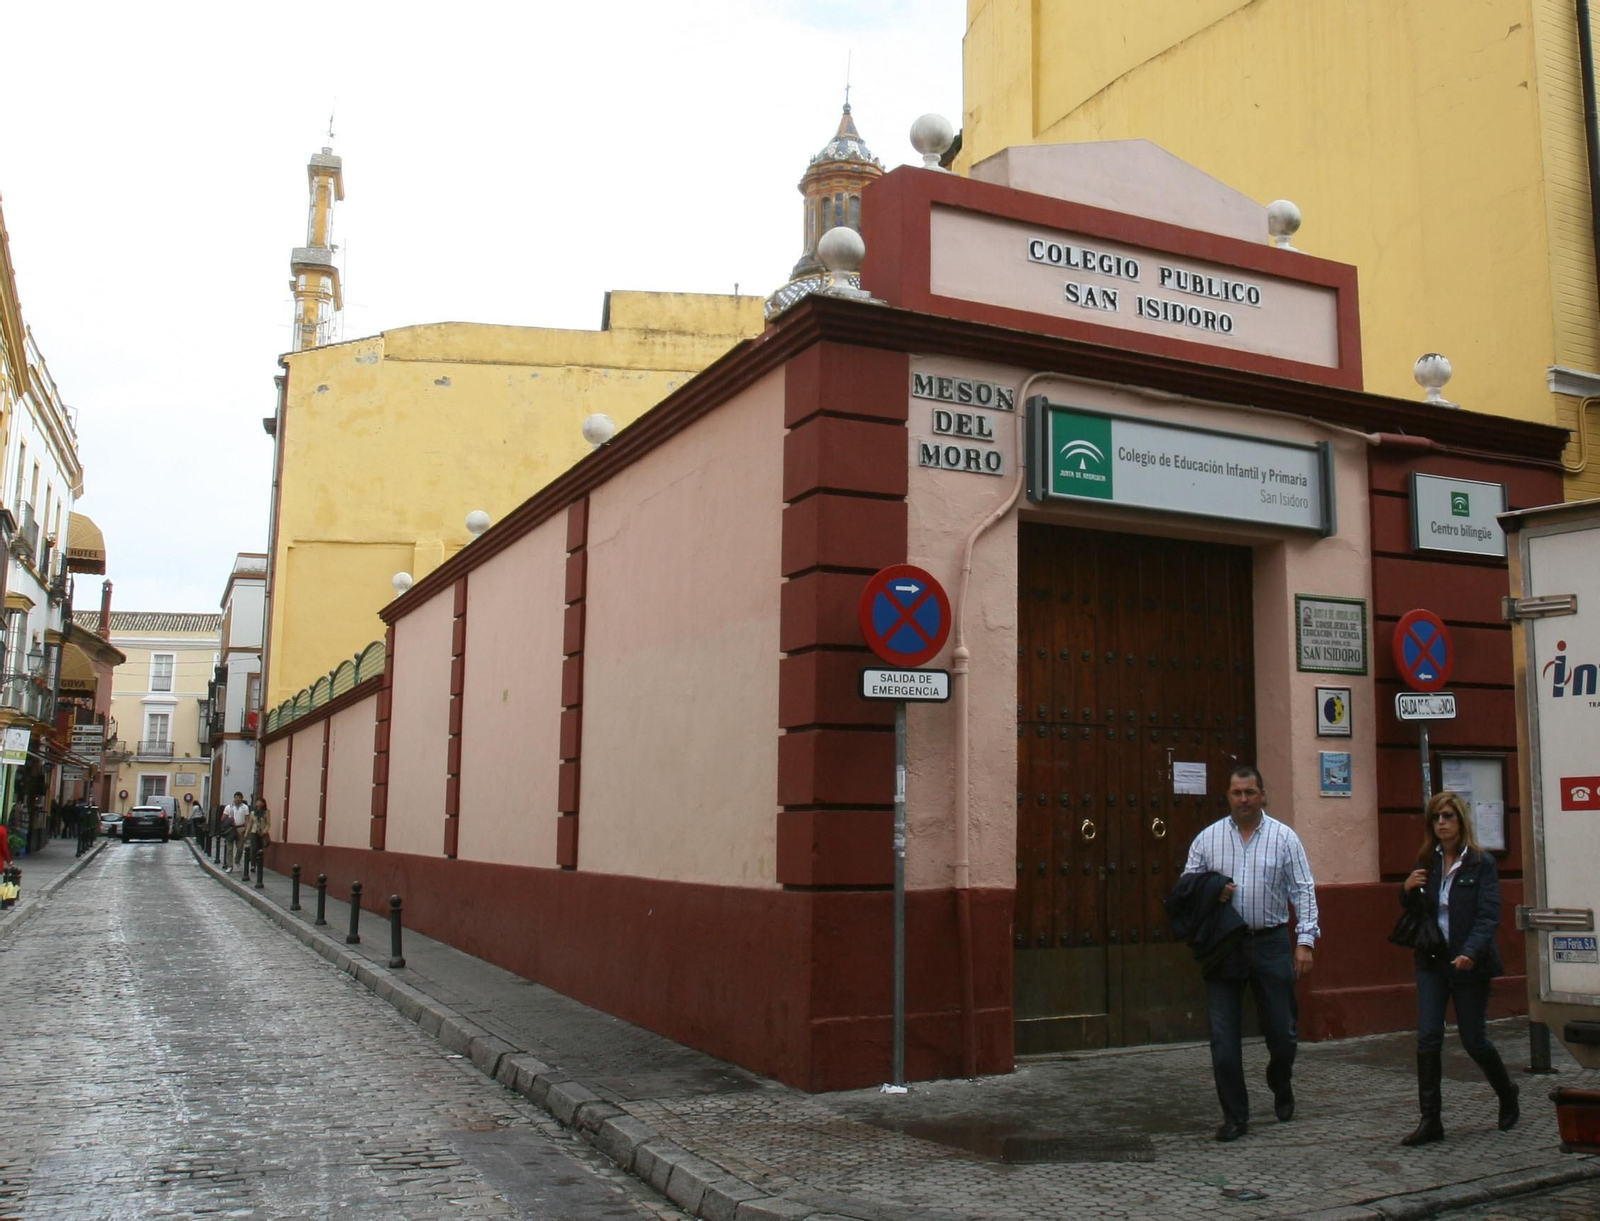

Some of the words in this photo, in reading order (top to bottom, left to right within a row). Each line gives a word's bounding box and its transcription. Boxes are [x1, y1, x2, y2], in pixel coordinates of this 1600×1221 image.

[1029, 239, 1139, 279] COLEGIO
[1159, 266, 1261, 305] PUBLICO
[1065, 282, 1118, 311] SAN
[1136, 294, 1233, 333] ISIDORO
[913, 373, 1014, 410] MESON
[934, 410, 993, 438] DEL
[920, 443, 1002, 472] MORO
[1118, 446, 1157, 467] Colegio
[1159, 455, 1171, 468] de
[1174, 454, 1224, 475] Educación
[1226, 462, 1259, 481] Infantil
[1260, 469, 1267, 484] y
[1269, 469, 1308, 488] Primaria
[1260, 489, 1278, 505] San
[1279, 490, 1309, 509] Isidoro
[1430, 520, 1459, 537] Centro
[1460, 524, 1492, 541] bilingüe
[70, 549, 99, 558] HOTEL
[1303, 645, 1321, 661] SAN
[1323, 646, 1361, 663] ISIDORO
[61, 680, 86, 689] GOYA
[880, 673, 916, 684] SALIDA
[918, 674, 932, 684] DE
[872, 685, 940, 697] EMERGENCIA
[1401, 698, 1418, 715] SALIDA
[1553, 938, 1567, 950] Juan
